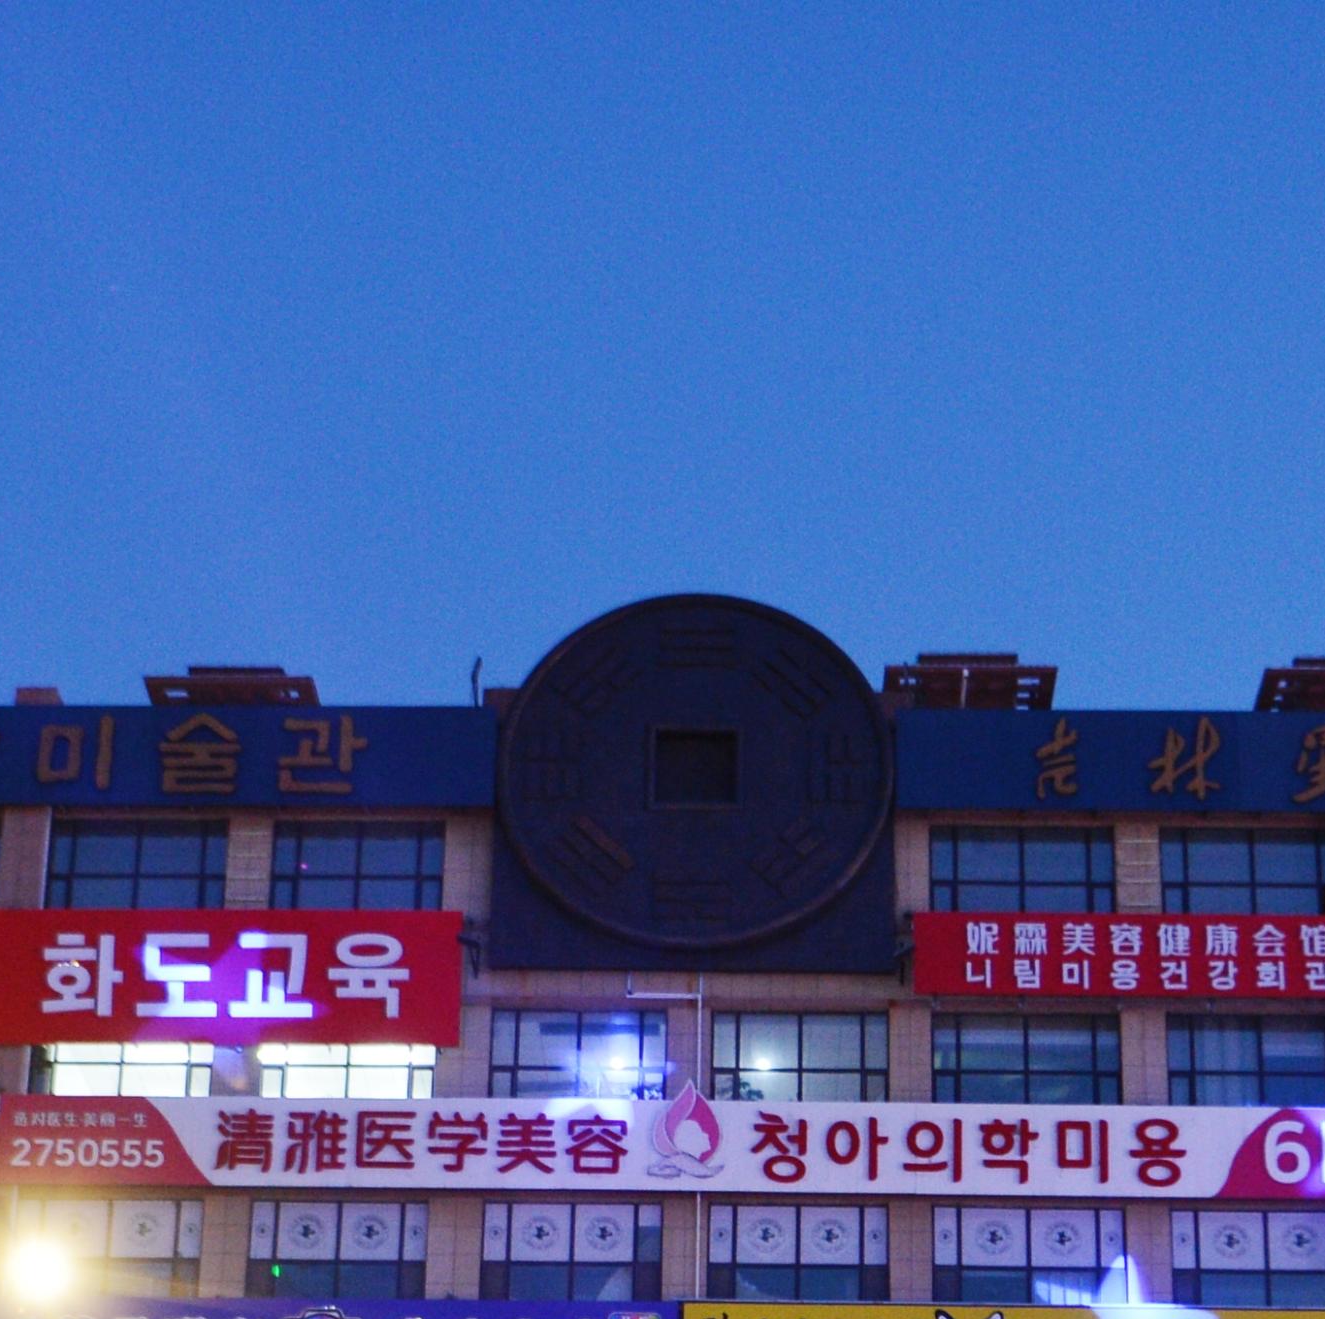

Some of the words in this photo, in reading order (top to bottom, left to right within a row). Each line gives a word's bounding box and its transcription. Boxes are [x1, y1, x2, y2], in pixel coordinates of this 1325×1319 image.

[42, 928, 412, 1020] 화도교육
[10, 1138, 165, 1168] 2750555
[214, 1110, 630, 1176] 清雅医学美容
[749, 1111, 1188, 1189] 청아의학미용
